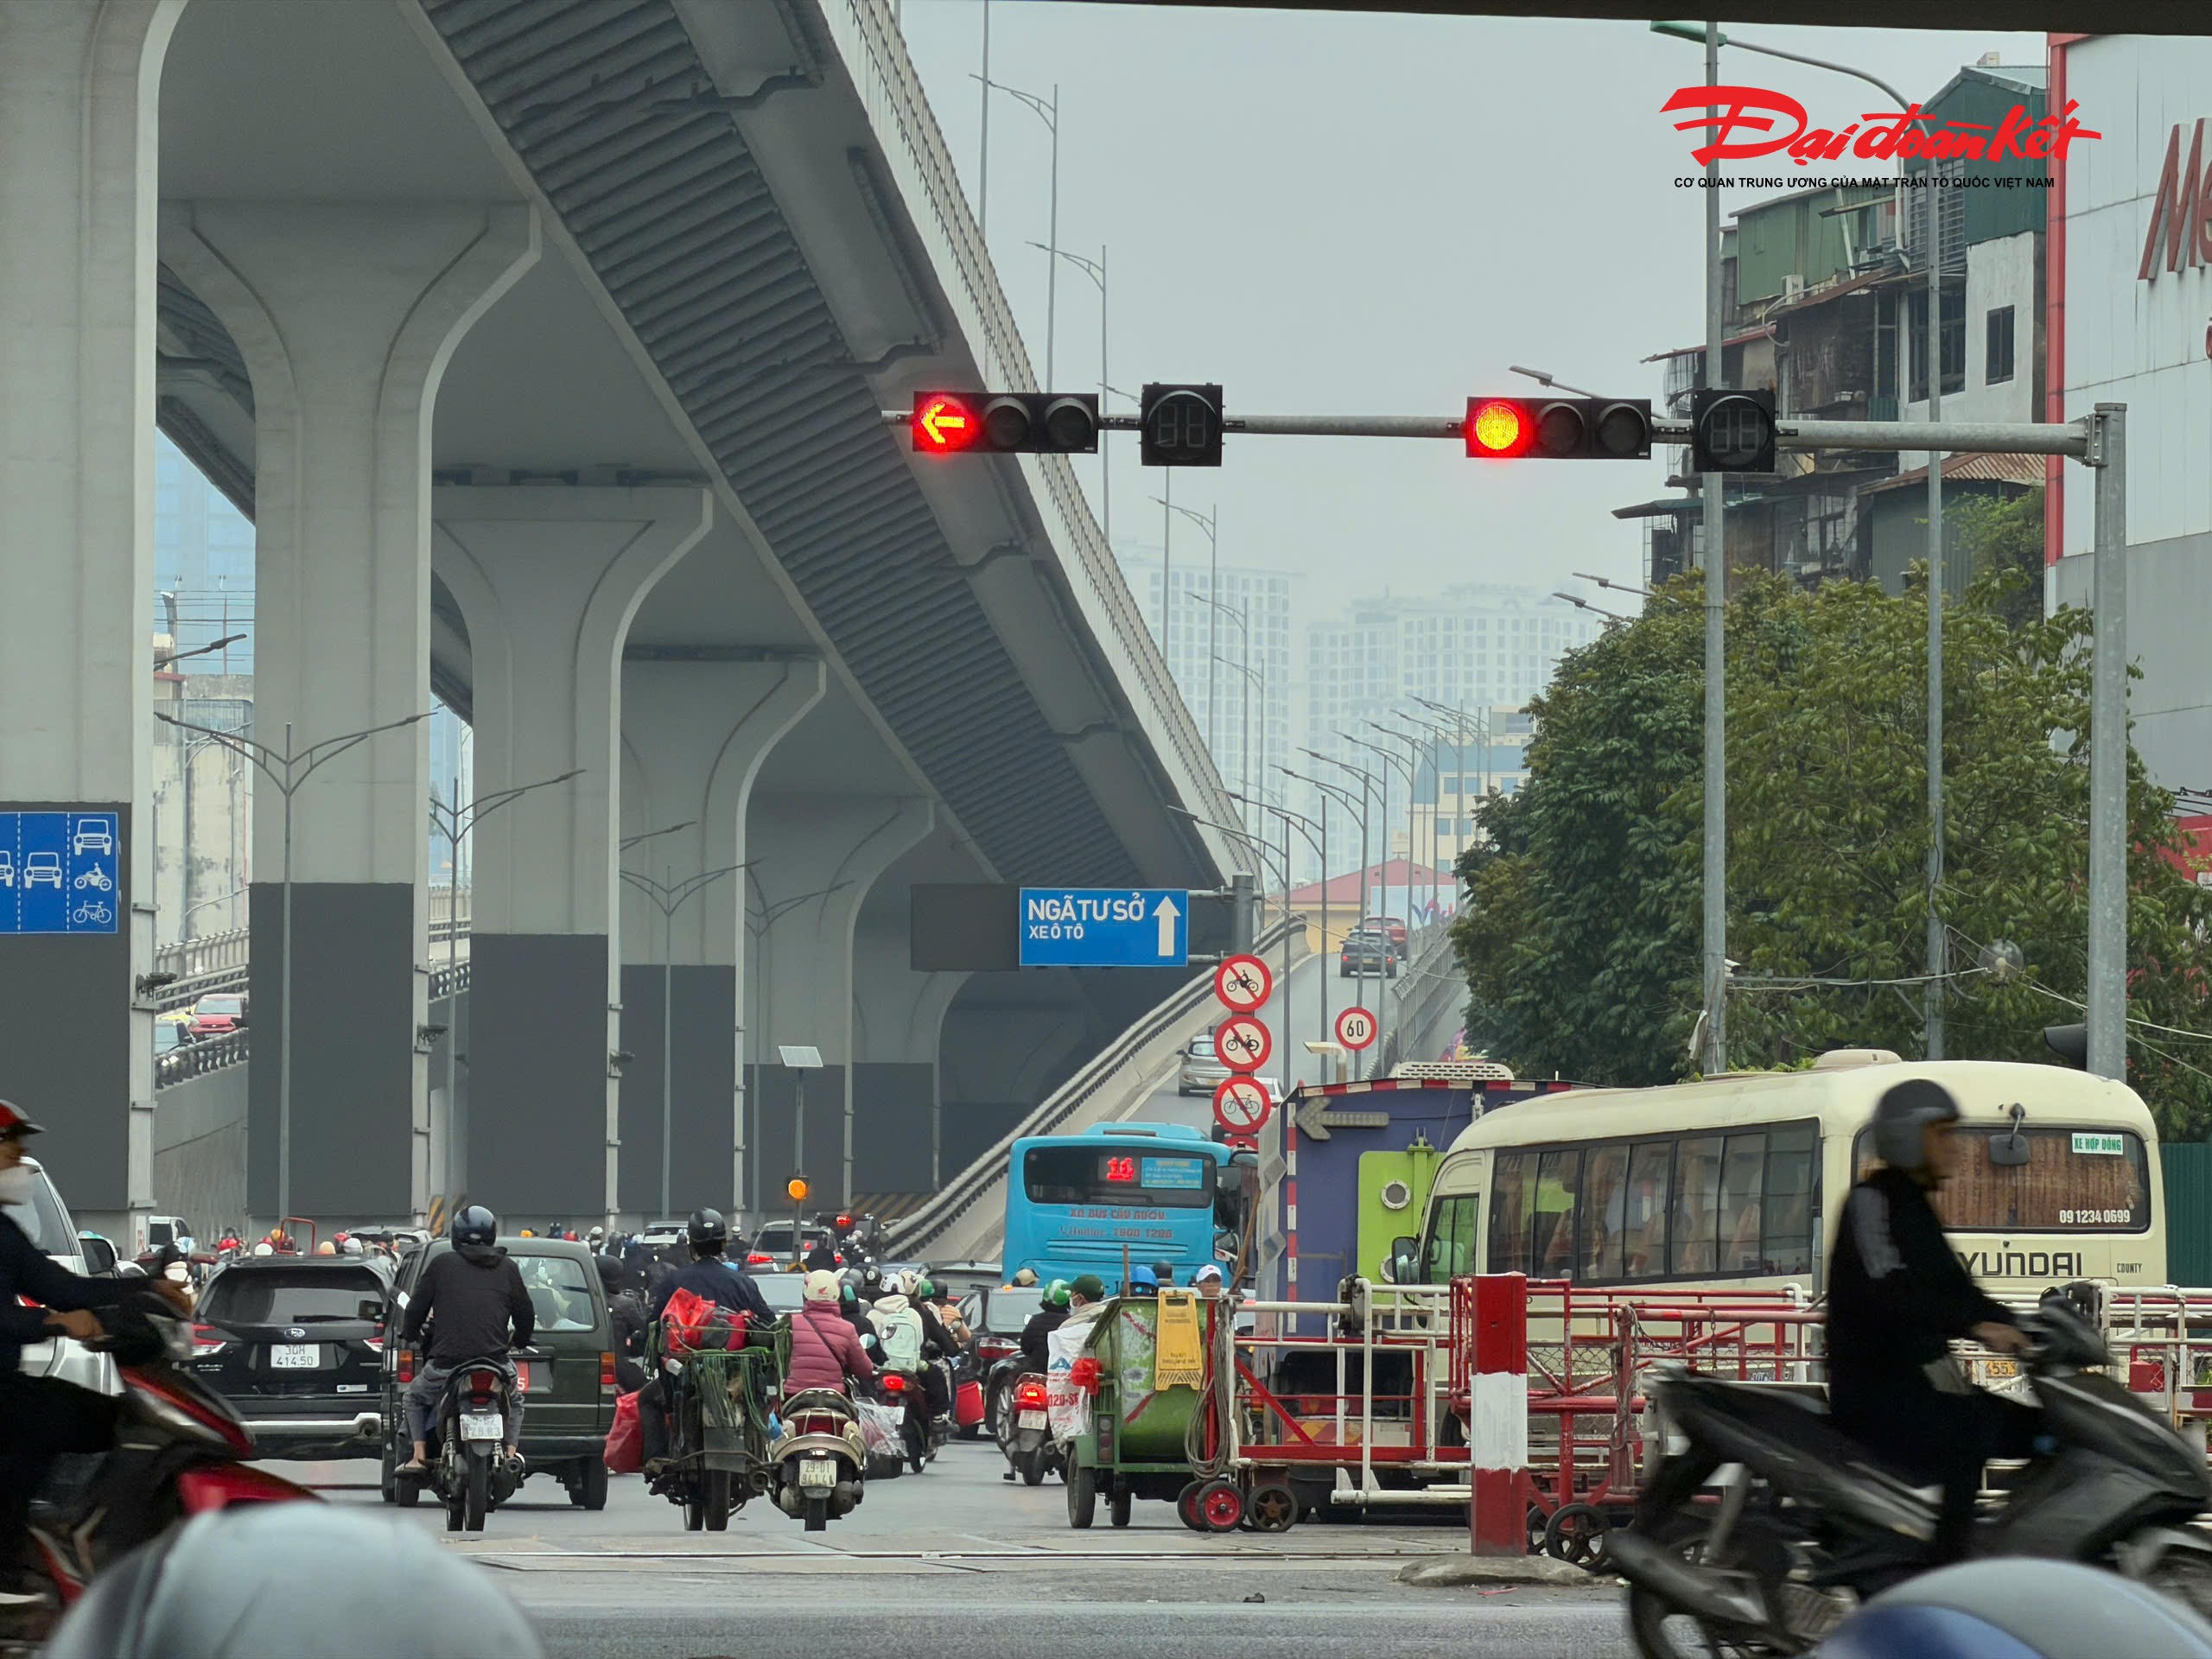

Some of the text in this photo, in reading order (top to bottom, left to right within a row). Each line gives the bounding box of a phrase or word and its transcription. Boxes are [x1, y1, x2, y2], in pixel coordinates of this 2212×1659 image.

[1028, 892, 1145, 921] NGÃ TƯ SỞ
[1029, 922, 1084, 940] XE Ô TÔ
[1347, 1020, 1364, 1037] 60
[2074, 1137, 2083, 1149] XE
[2085, 1137, 2100, 1150] HỢP
[2059, 1209, 2131, 1224] 09 1234 0699
[2116, 1262, 2143, 1274] COUNTY
